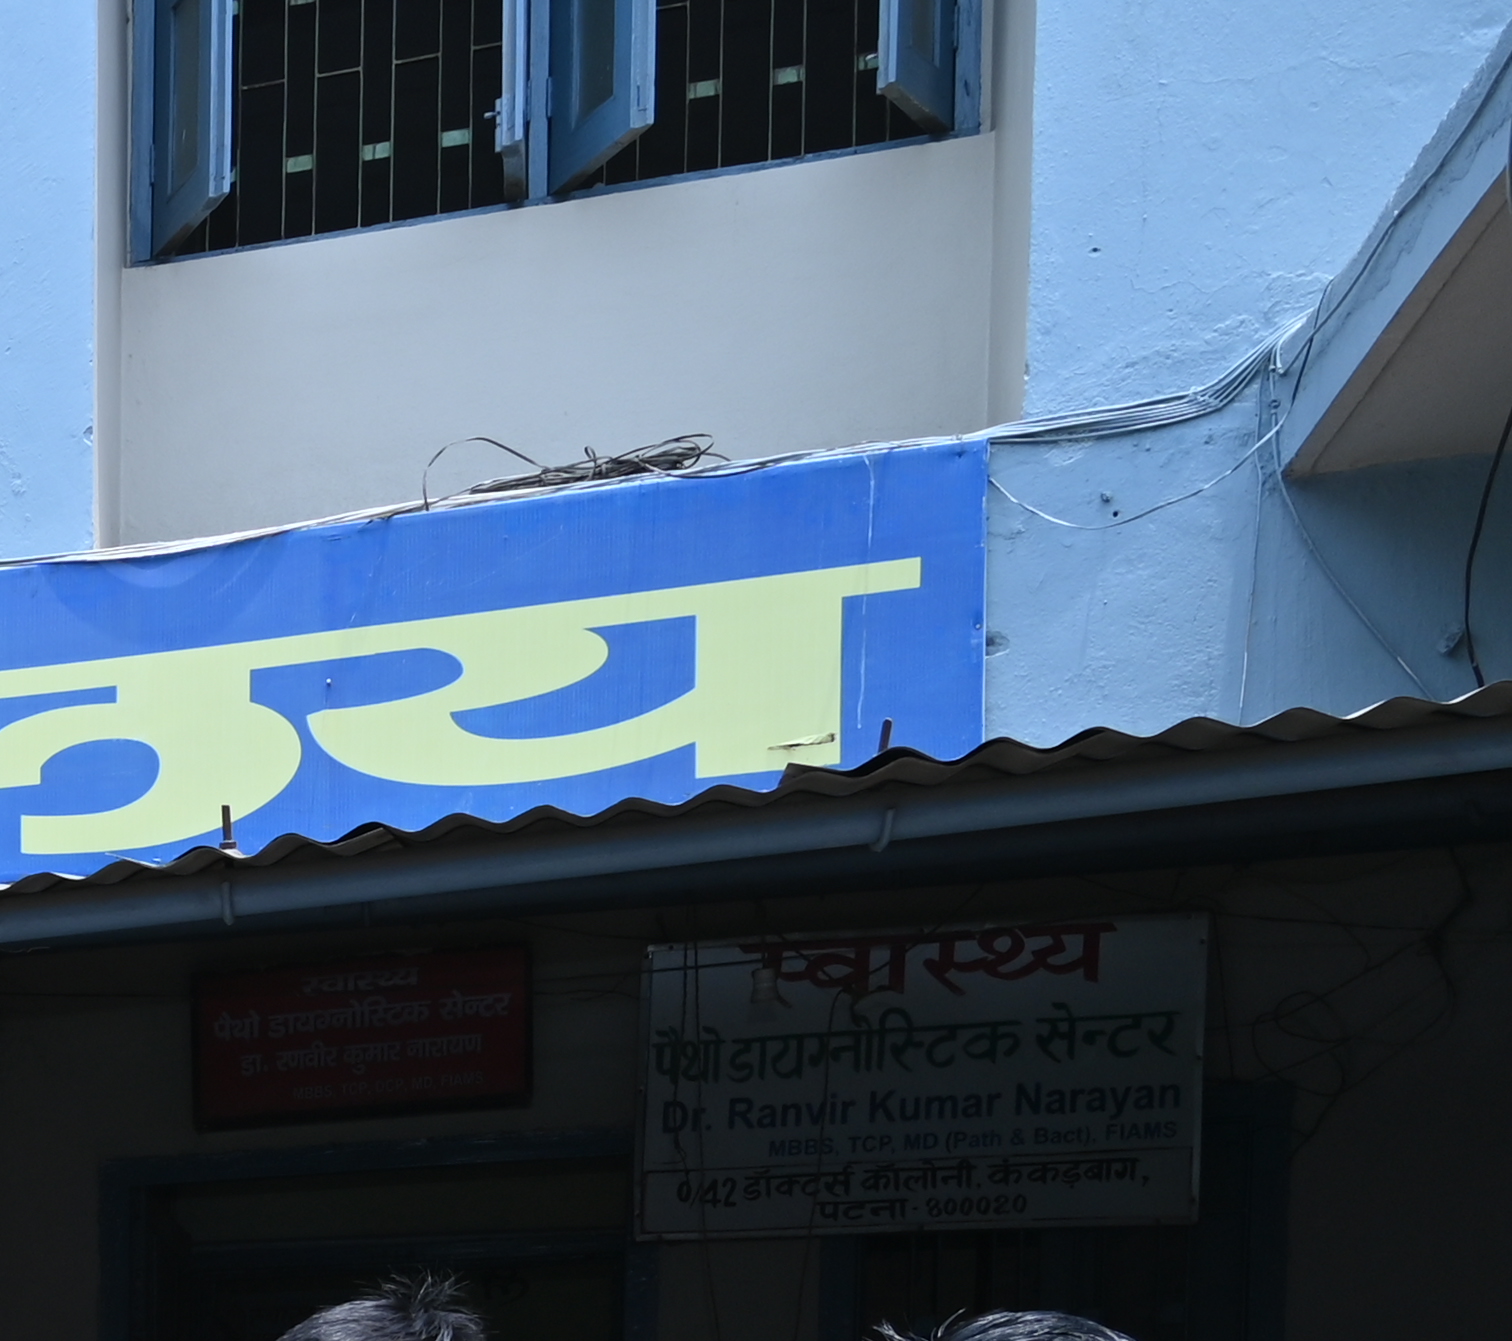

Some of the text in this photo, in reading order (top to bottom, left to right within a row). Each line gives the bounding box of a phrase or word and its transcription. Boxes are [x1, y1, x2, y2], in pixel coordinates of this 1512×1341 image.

[343, 1039, 401, 1076] कुमार
[407, 1032, 483, 1058] नारायण
[441, 1069, 484, 1089] FIAMS
[663, 1082, 1181, 1135] Dr. Ranvir Kumar Narayan
[903, 1132, 939, 1152] MD
[945, 1127, 1004, 1154] (Path
[1010, 1128, 1026, 1146] &
[1104, 1120, 1178, 1141] FIAMS
